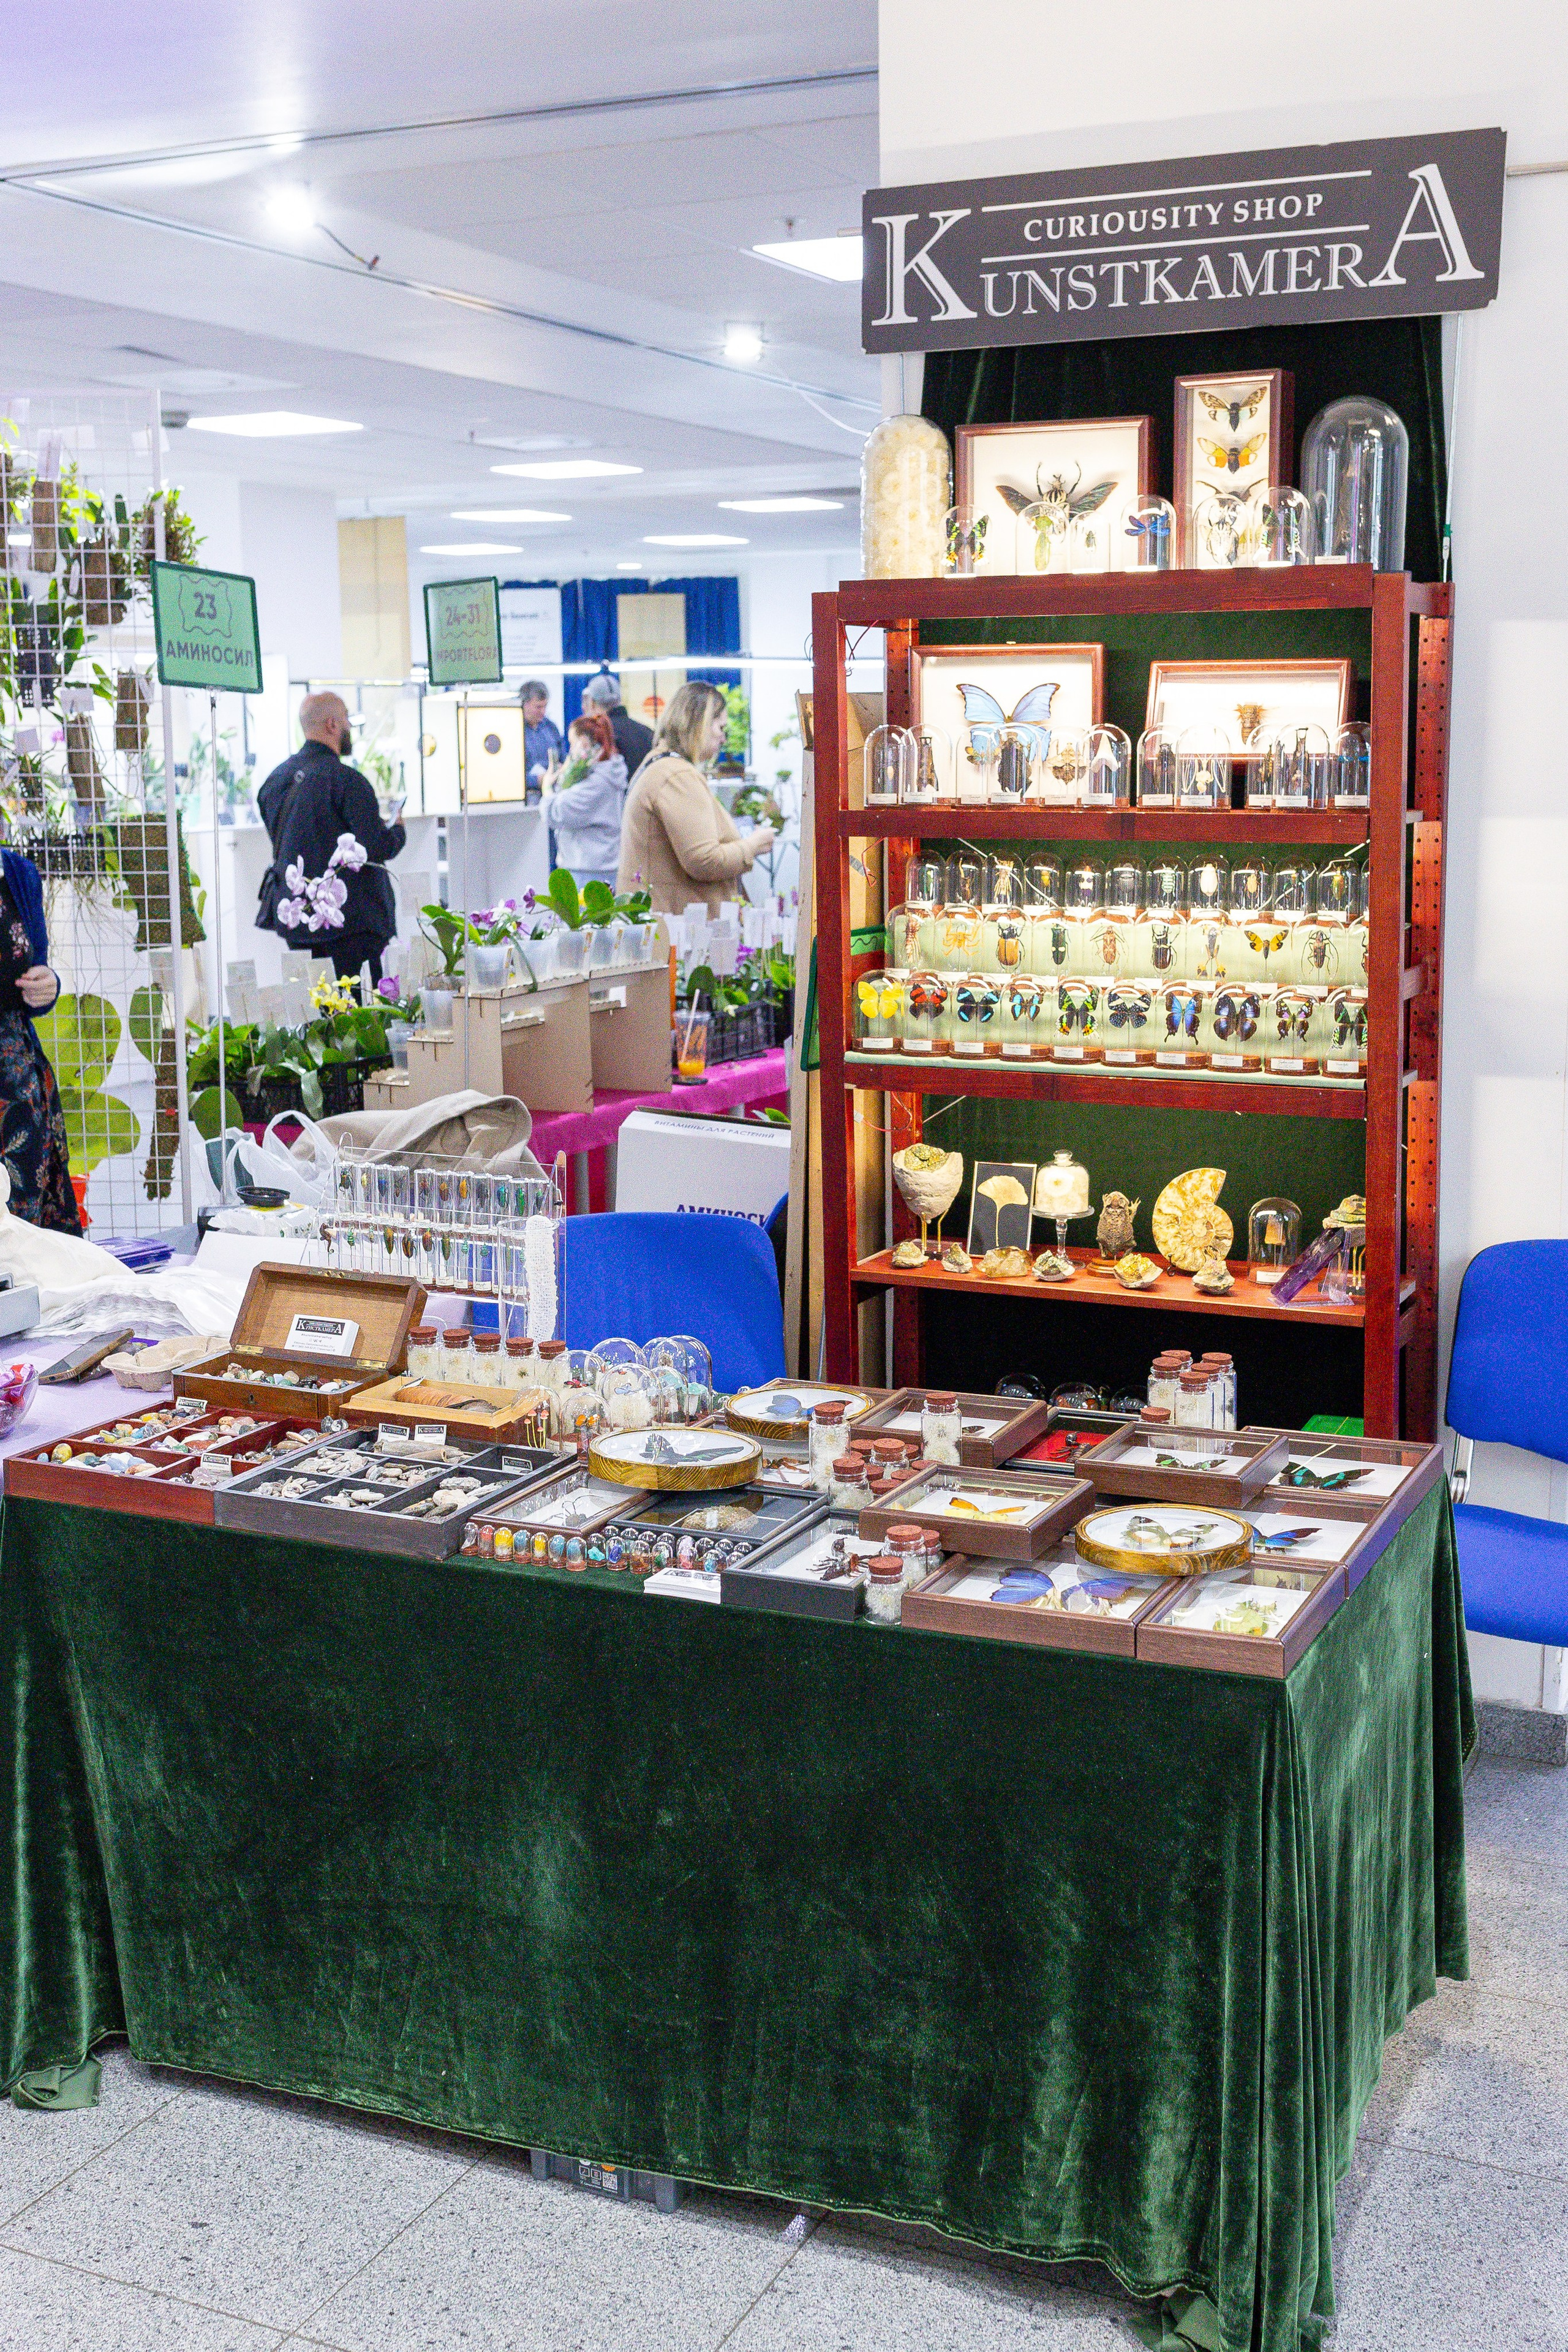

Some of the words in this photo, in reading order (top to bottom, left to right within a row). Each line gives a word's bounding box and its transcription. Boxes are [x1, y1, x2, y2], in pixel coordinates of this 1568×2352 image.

[1023, 200, 1224, 243] CURIOUSITY
[1233, 193, 1324, 225] SHOP
[872, 163, 1485, 326] KUNSTKAMERA
[193, 591, 217, 620] 23
[166, 639, 254, 667] АМИНОСИЛ
[654, 1120, 704, 1131] ВИТАМИНЫ
[728, 1129, 775, 1139] РАСТЕНИЙ
